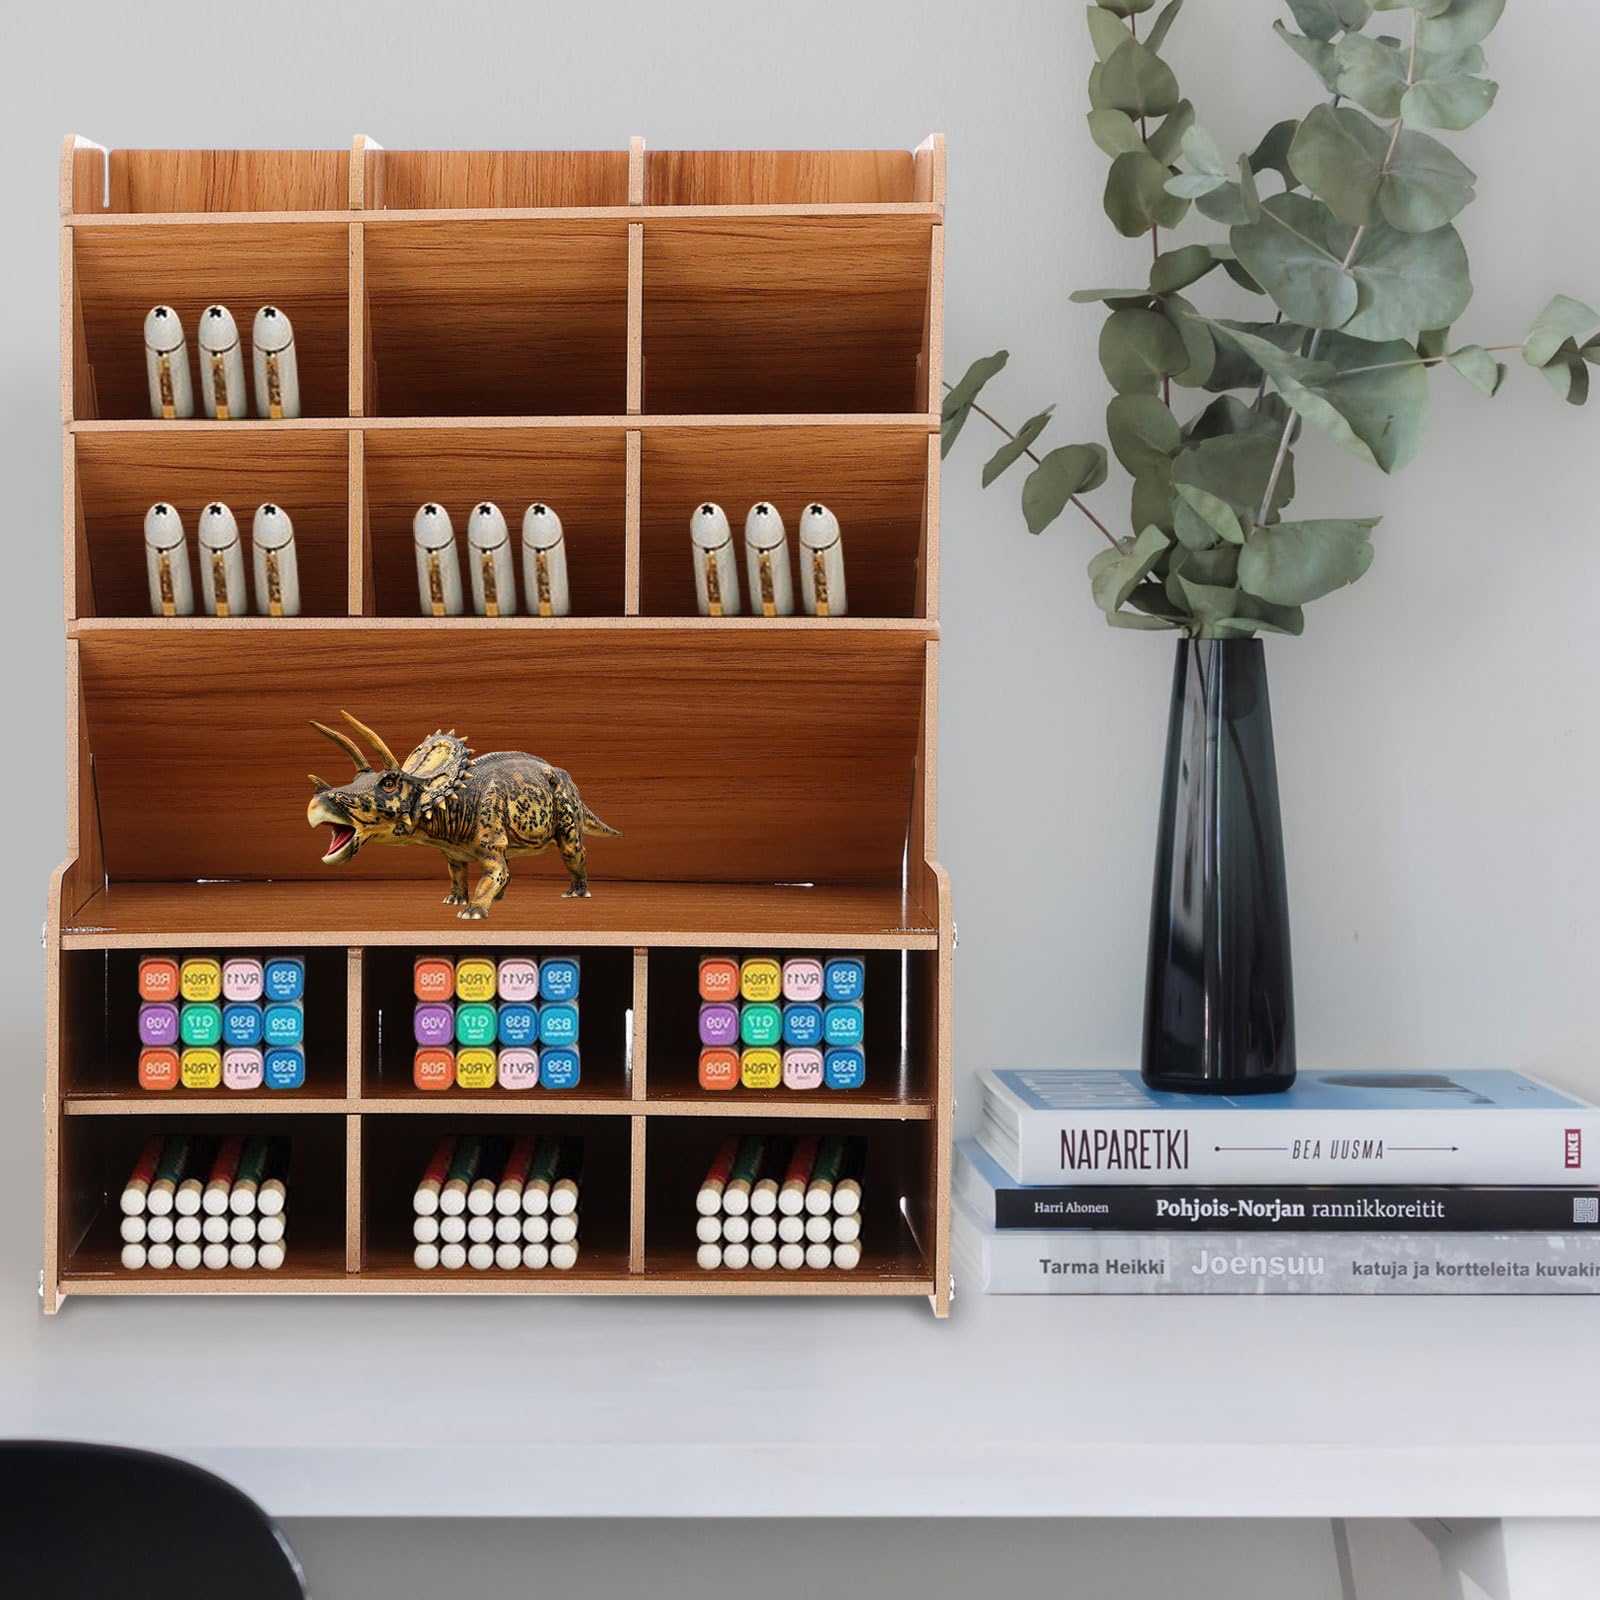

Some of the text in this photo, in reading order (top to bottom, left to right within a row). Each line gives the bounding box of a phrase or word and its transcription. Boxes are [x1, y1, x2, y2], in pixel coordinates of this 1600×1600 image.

[1060, 1129, 1189, 1170] NAPARETKI
[1292, 1139, 1384, 1160] BEA UUSMA
[1567, 1132, 1580, 1165] LIKE
[1034, 1202, 1109, 1214] Harri Ahonen
[1156, 1198, 1445, 1221] Pohjois-Norjan rannikkoreitit
[1039, 1258, 1165, 1275] Tarma Heikki
[1191, 1250, 1325, 1276] Joensuu
[1352, 1261, 1408, 1279] katuja
[1412, 1261, 1430, 1279] ja
[1436, 1261, 1530, 1277] kortteleita
